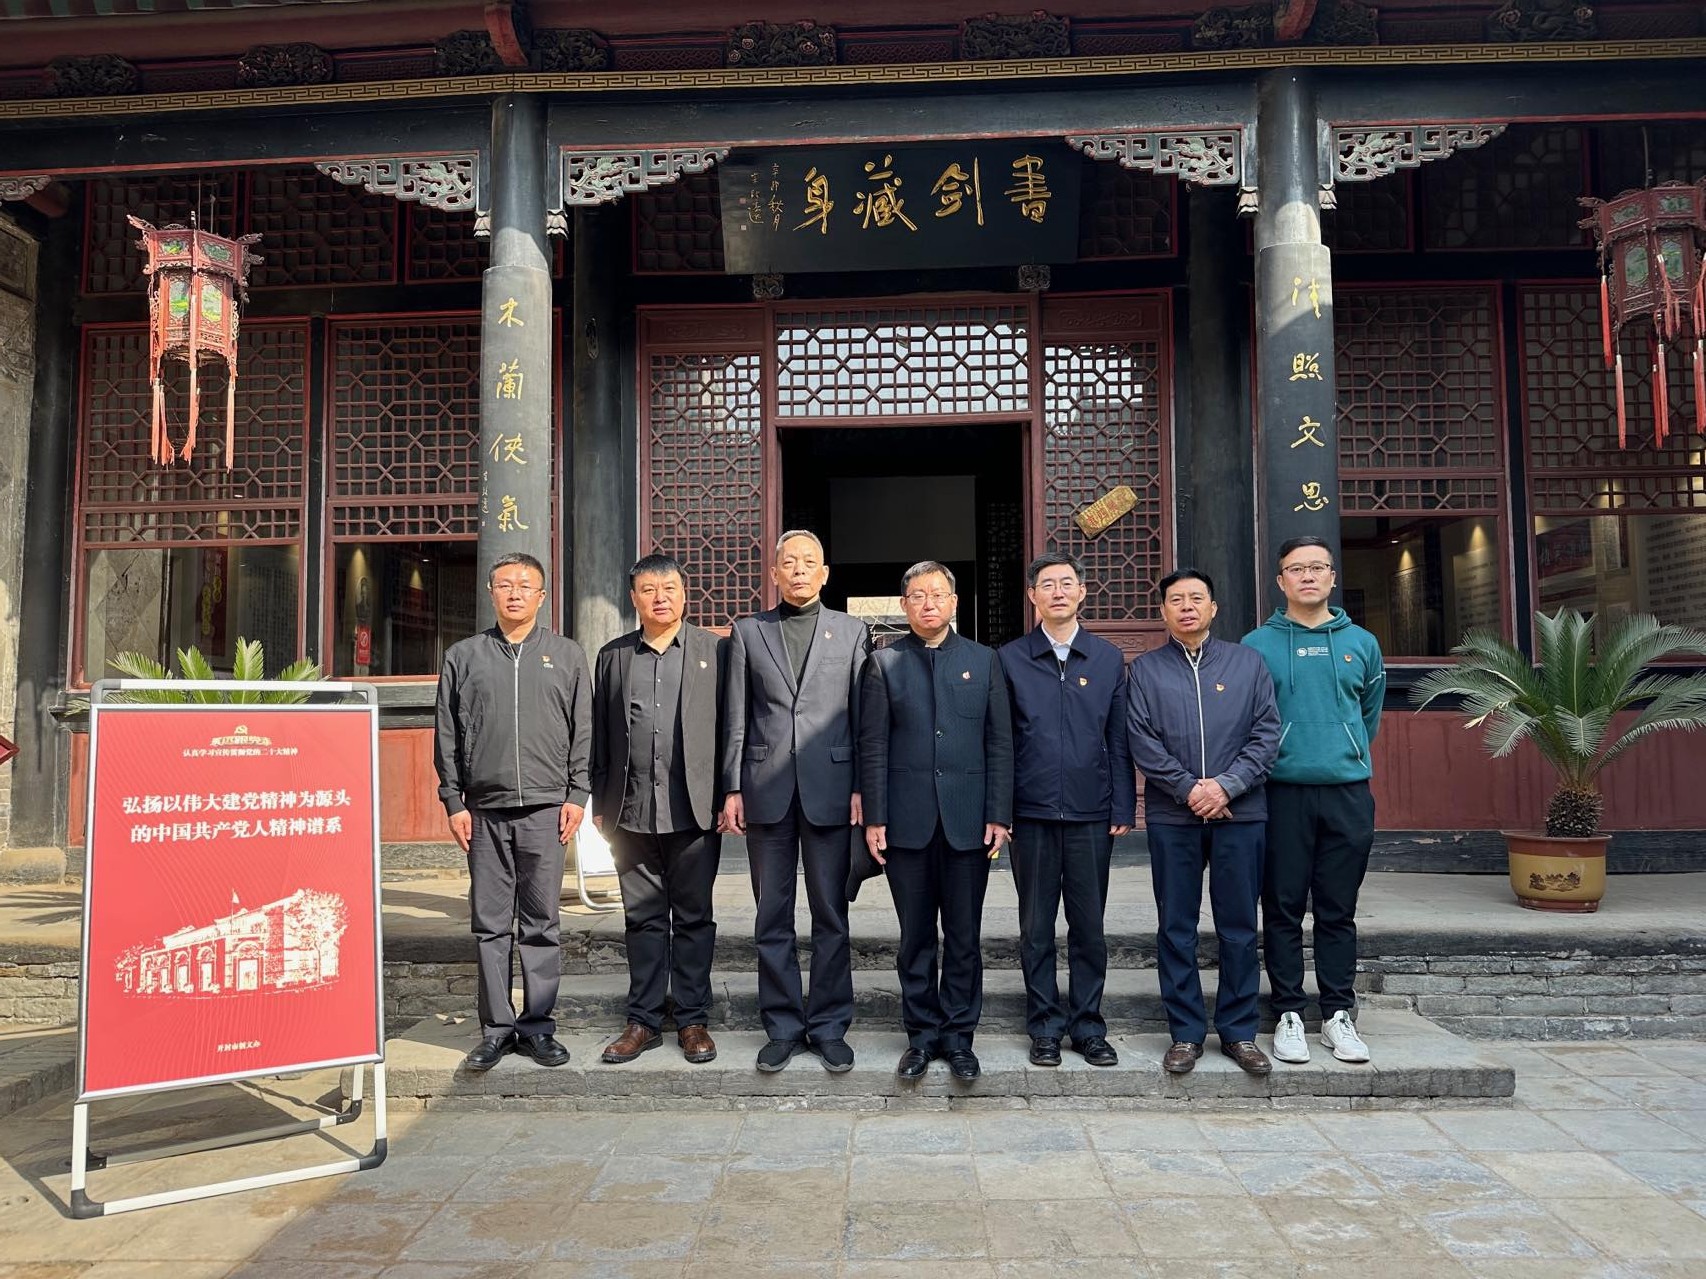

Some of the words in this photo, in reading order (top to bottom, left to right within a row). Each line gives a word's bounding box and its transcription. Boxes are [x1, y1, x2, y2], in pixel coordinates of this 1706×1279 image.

[122, 789, 351, 814] 弘扬以伟大建党精神为源头
[130, 817, 342, 843] 的中国共产党人精神谱系
